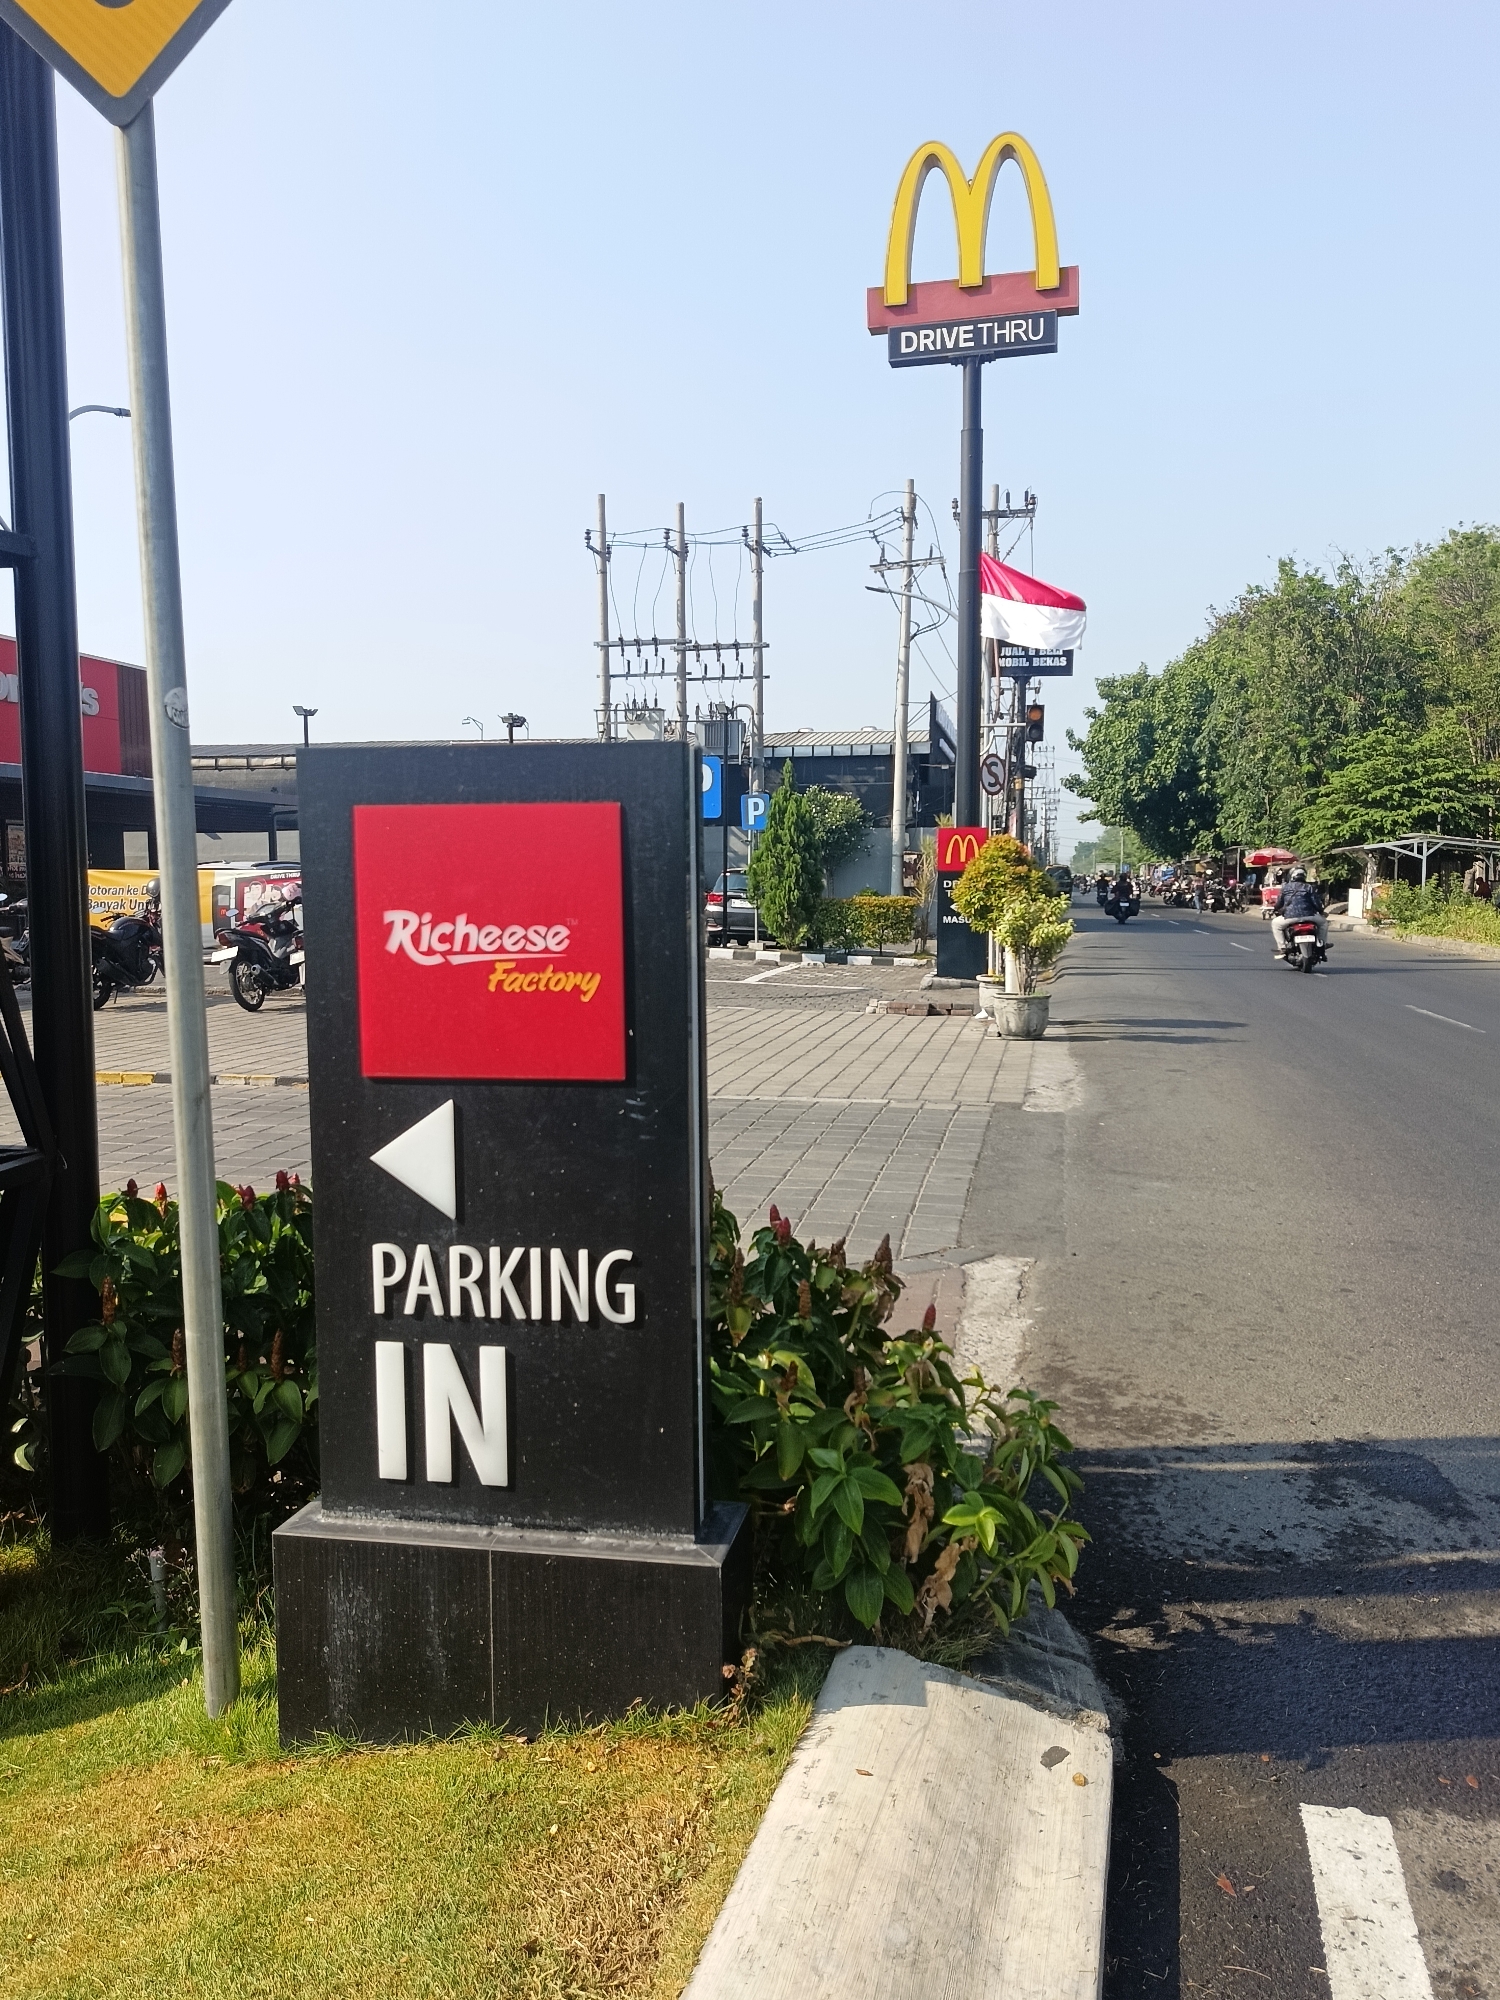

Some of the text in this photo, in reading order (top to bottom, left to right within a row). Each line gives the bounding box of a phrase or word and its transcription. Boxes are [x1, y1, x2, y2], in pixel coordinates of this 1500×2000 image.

[900, 317, 1044, 353] DRIVE THRU
[999, 657, 1067, 666] MOBIL BEKAS
[1000, 647, 1025, 656] JUAL
[748, 798, 764, 825] P
[88, 885, 124, 896] otoran
[127, 885, 139, 896] ke
[383, 909, 571, 965] Richeese
[488, 961, 601, 1002] Factory
[372, 1243, 636, 1324] PARKING
[375, 1341, 508, 1487] IN
